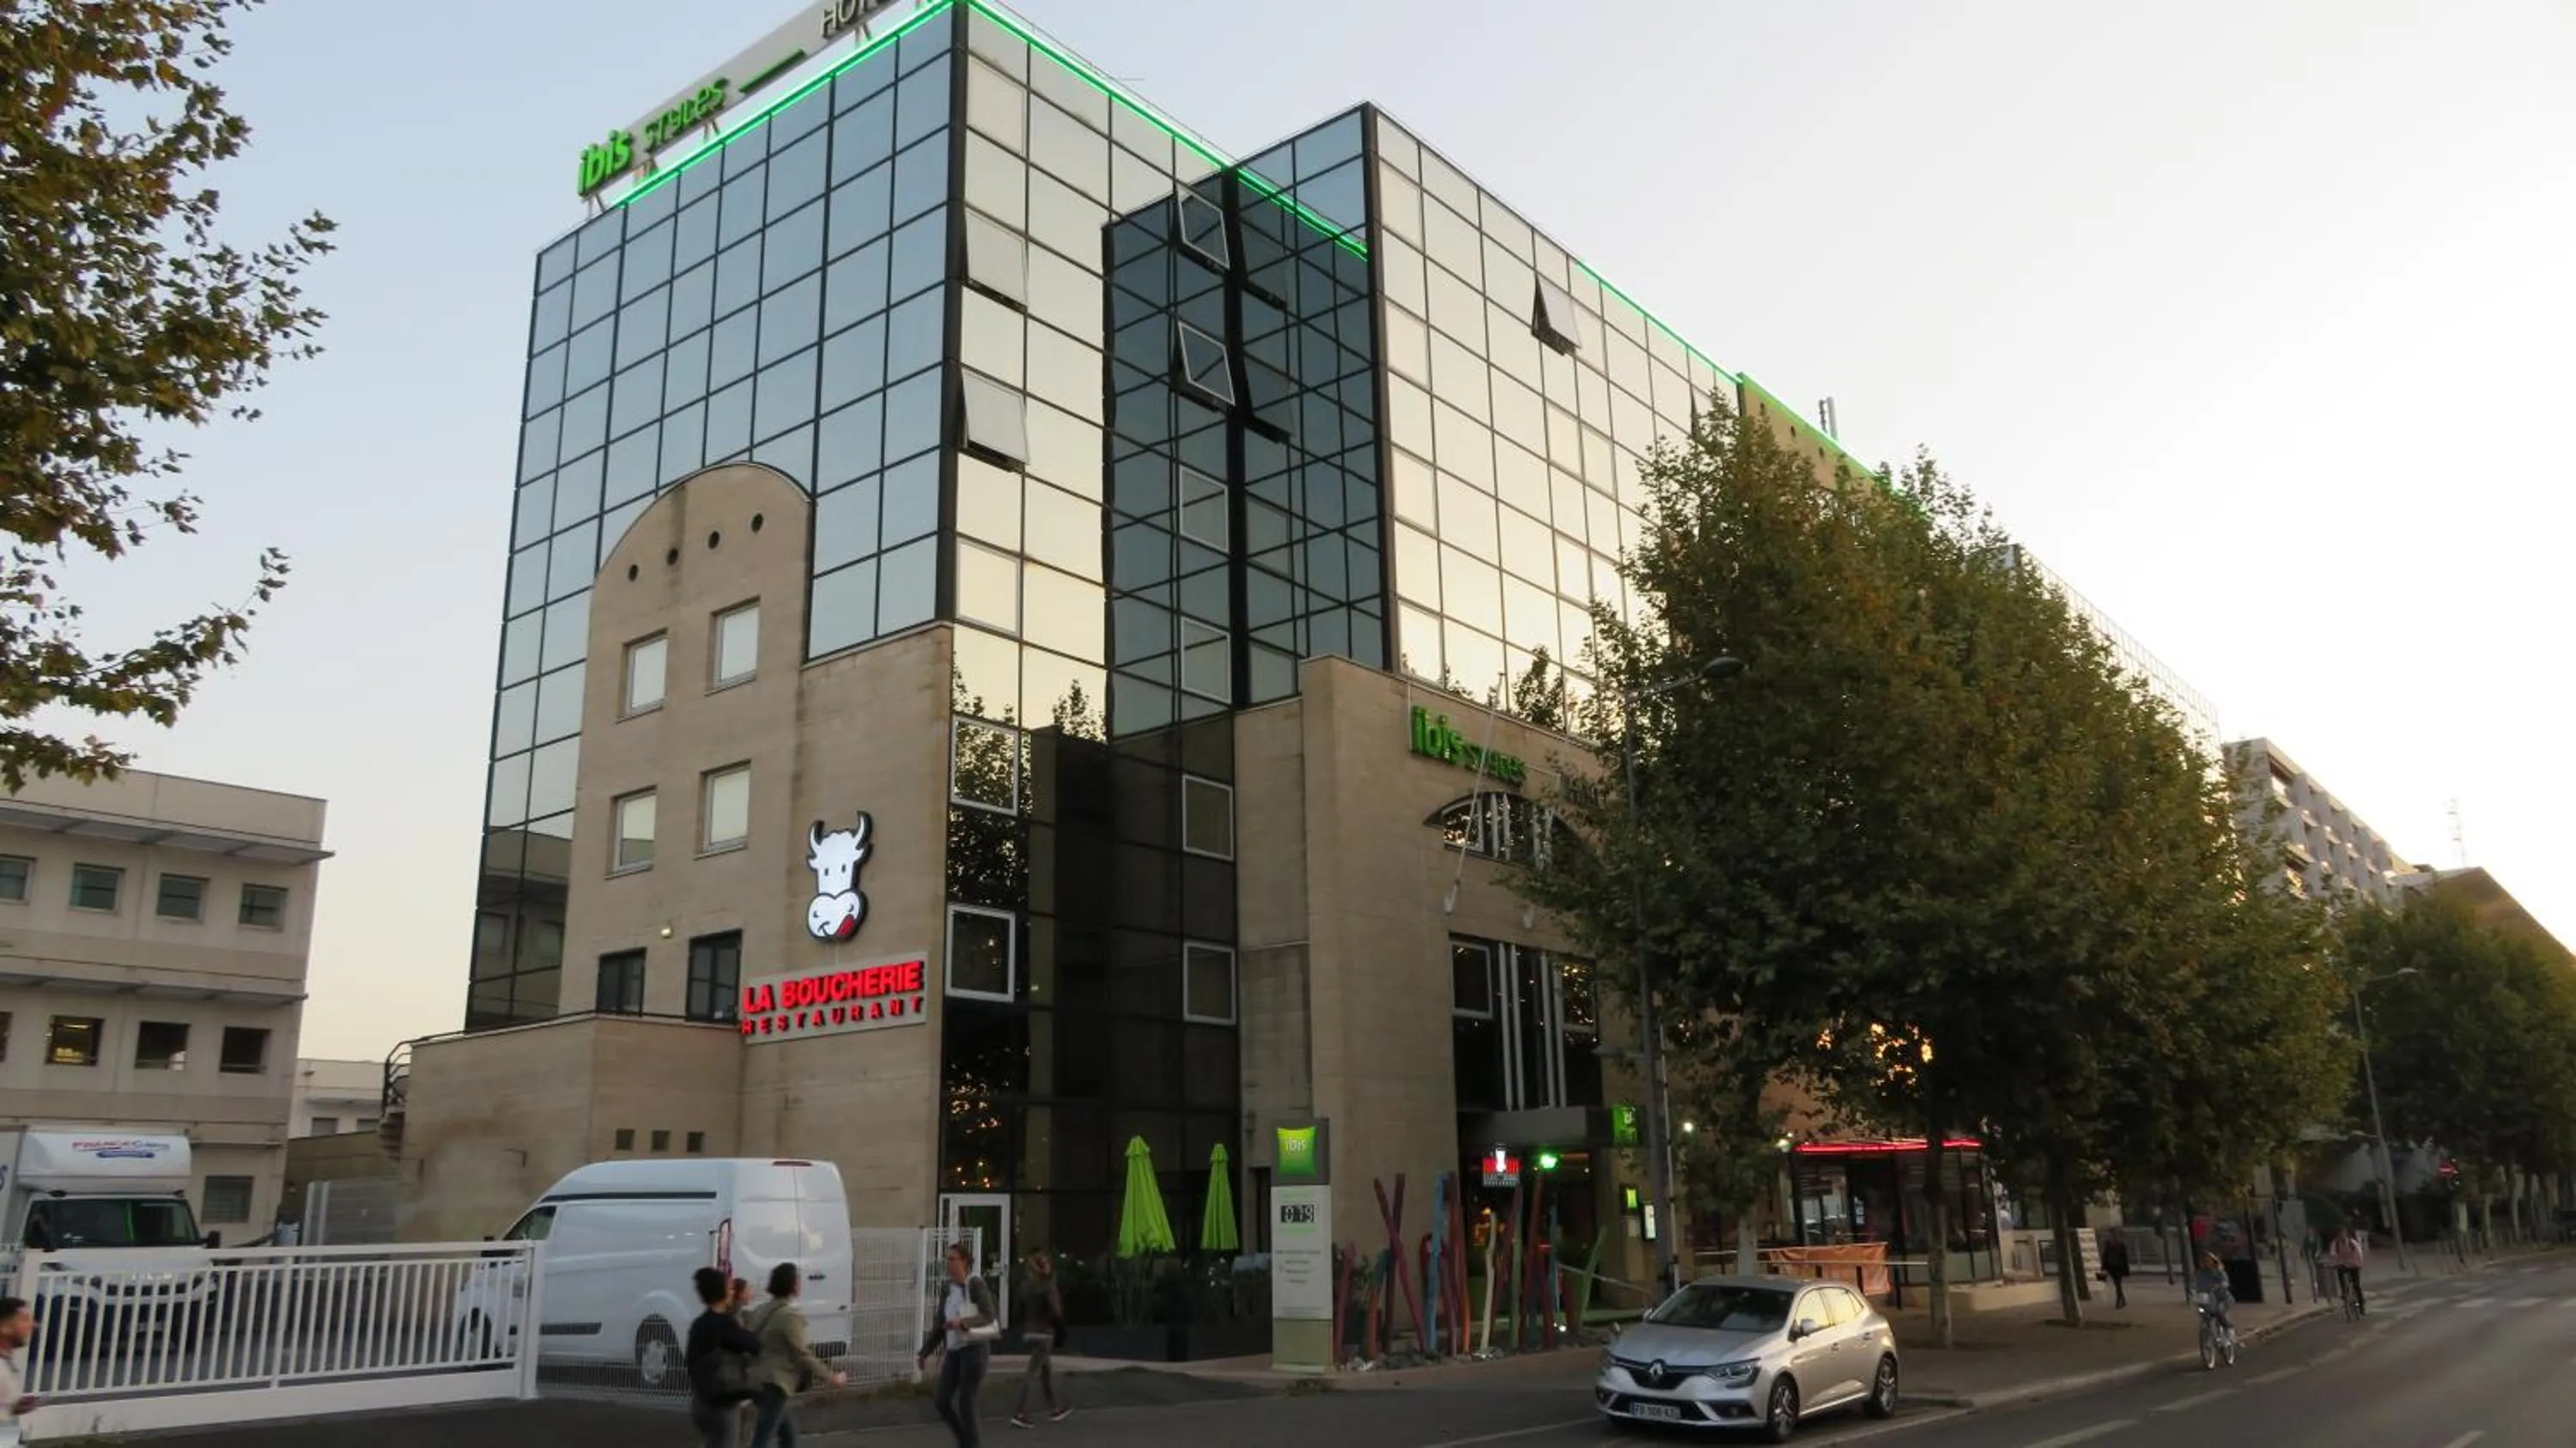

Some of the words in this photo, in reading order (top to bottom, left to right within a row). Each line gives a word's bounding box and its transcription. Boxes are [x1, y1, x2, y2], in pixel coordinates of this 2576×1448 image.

[577, 130, 633, 196] ibis
[1411, 706, 1463, 765] ibis
[743, 984, 775, 1014] LA
[779, 961, 925, 1010] BOUCHERIE
[741, 996, 925, 1036] RESTAURANT
